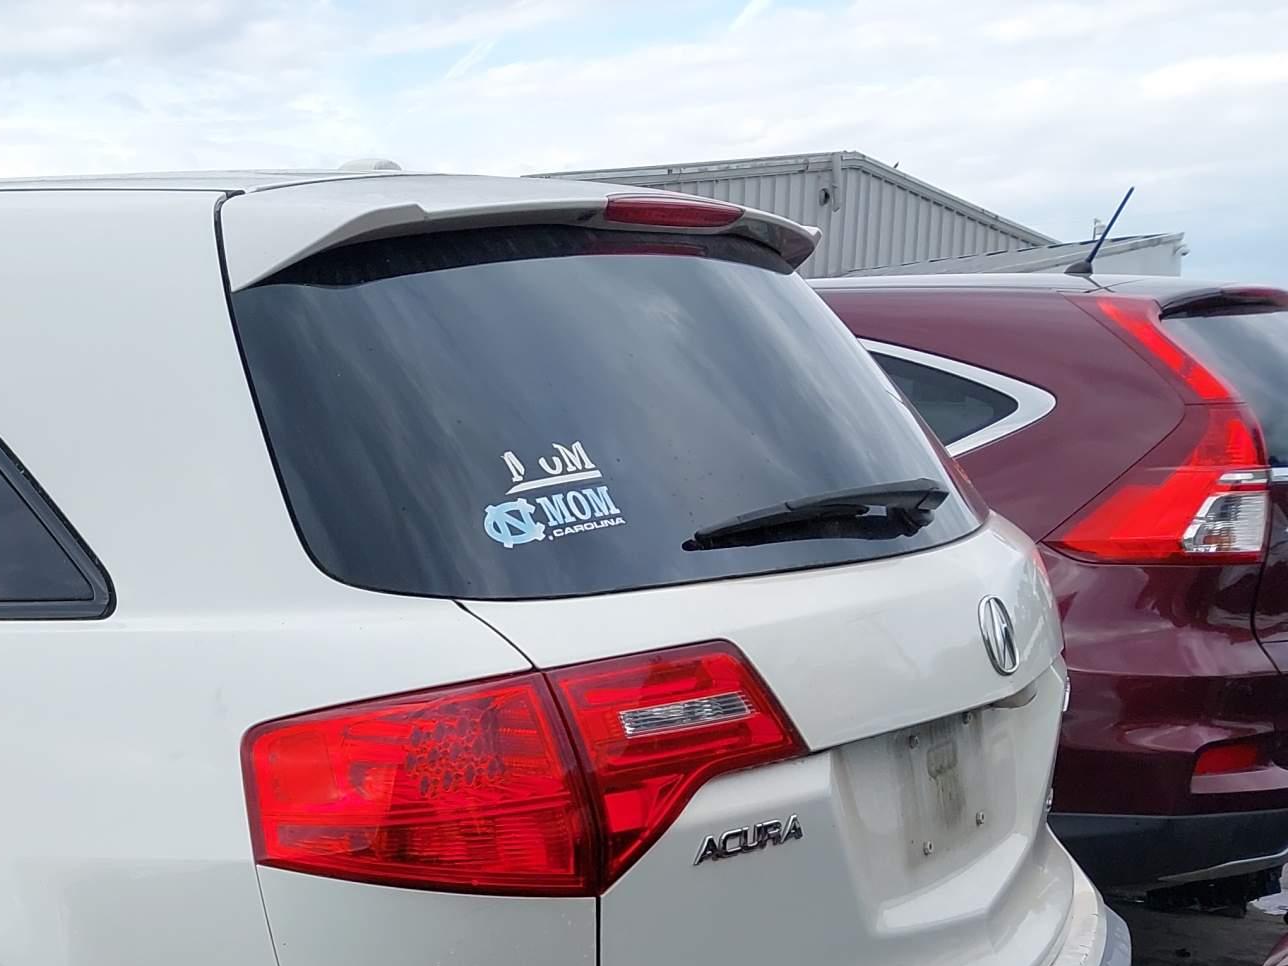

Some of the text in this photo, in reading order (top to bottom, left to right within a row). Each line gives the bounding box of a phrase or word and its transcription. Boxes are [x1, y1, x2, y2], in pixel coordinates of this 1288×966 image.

[536, 486, 620, 526] MOM
[552, 516, 626, 538] CAROLINA
[693, 814, 803, 865] ACURA
